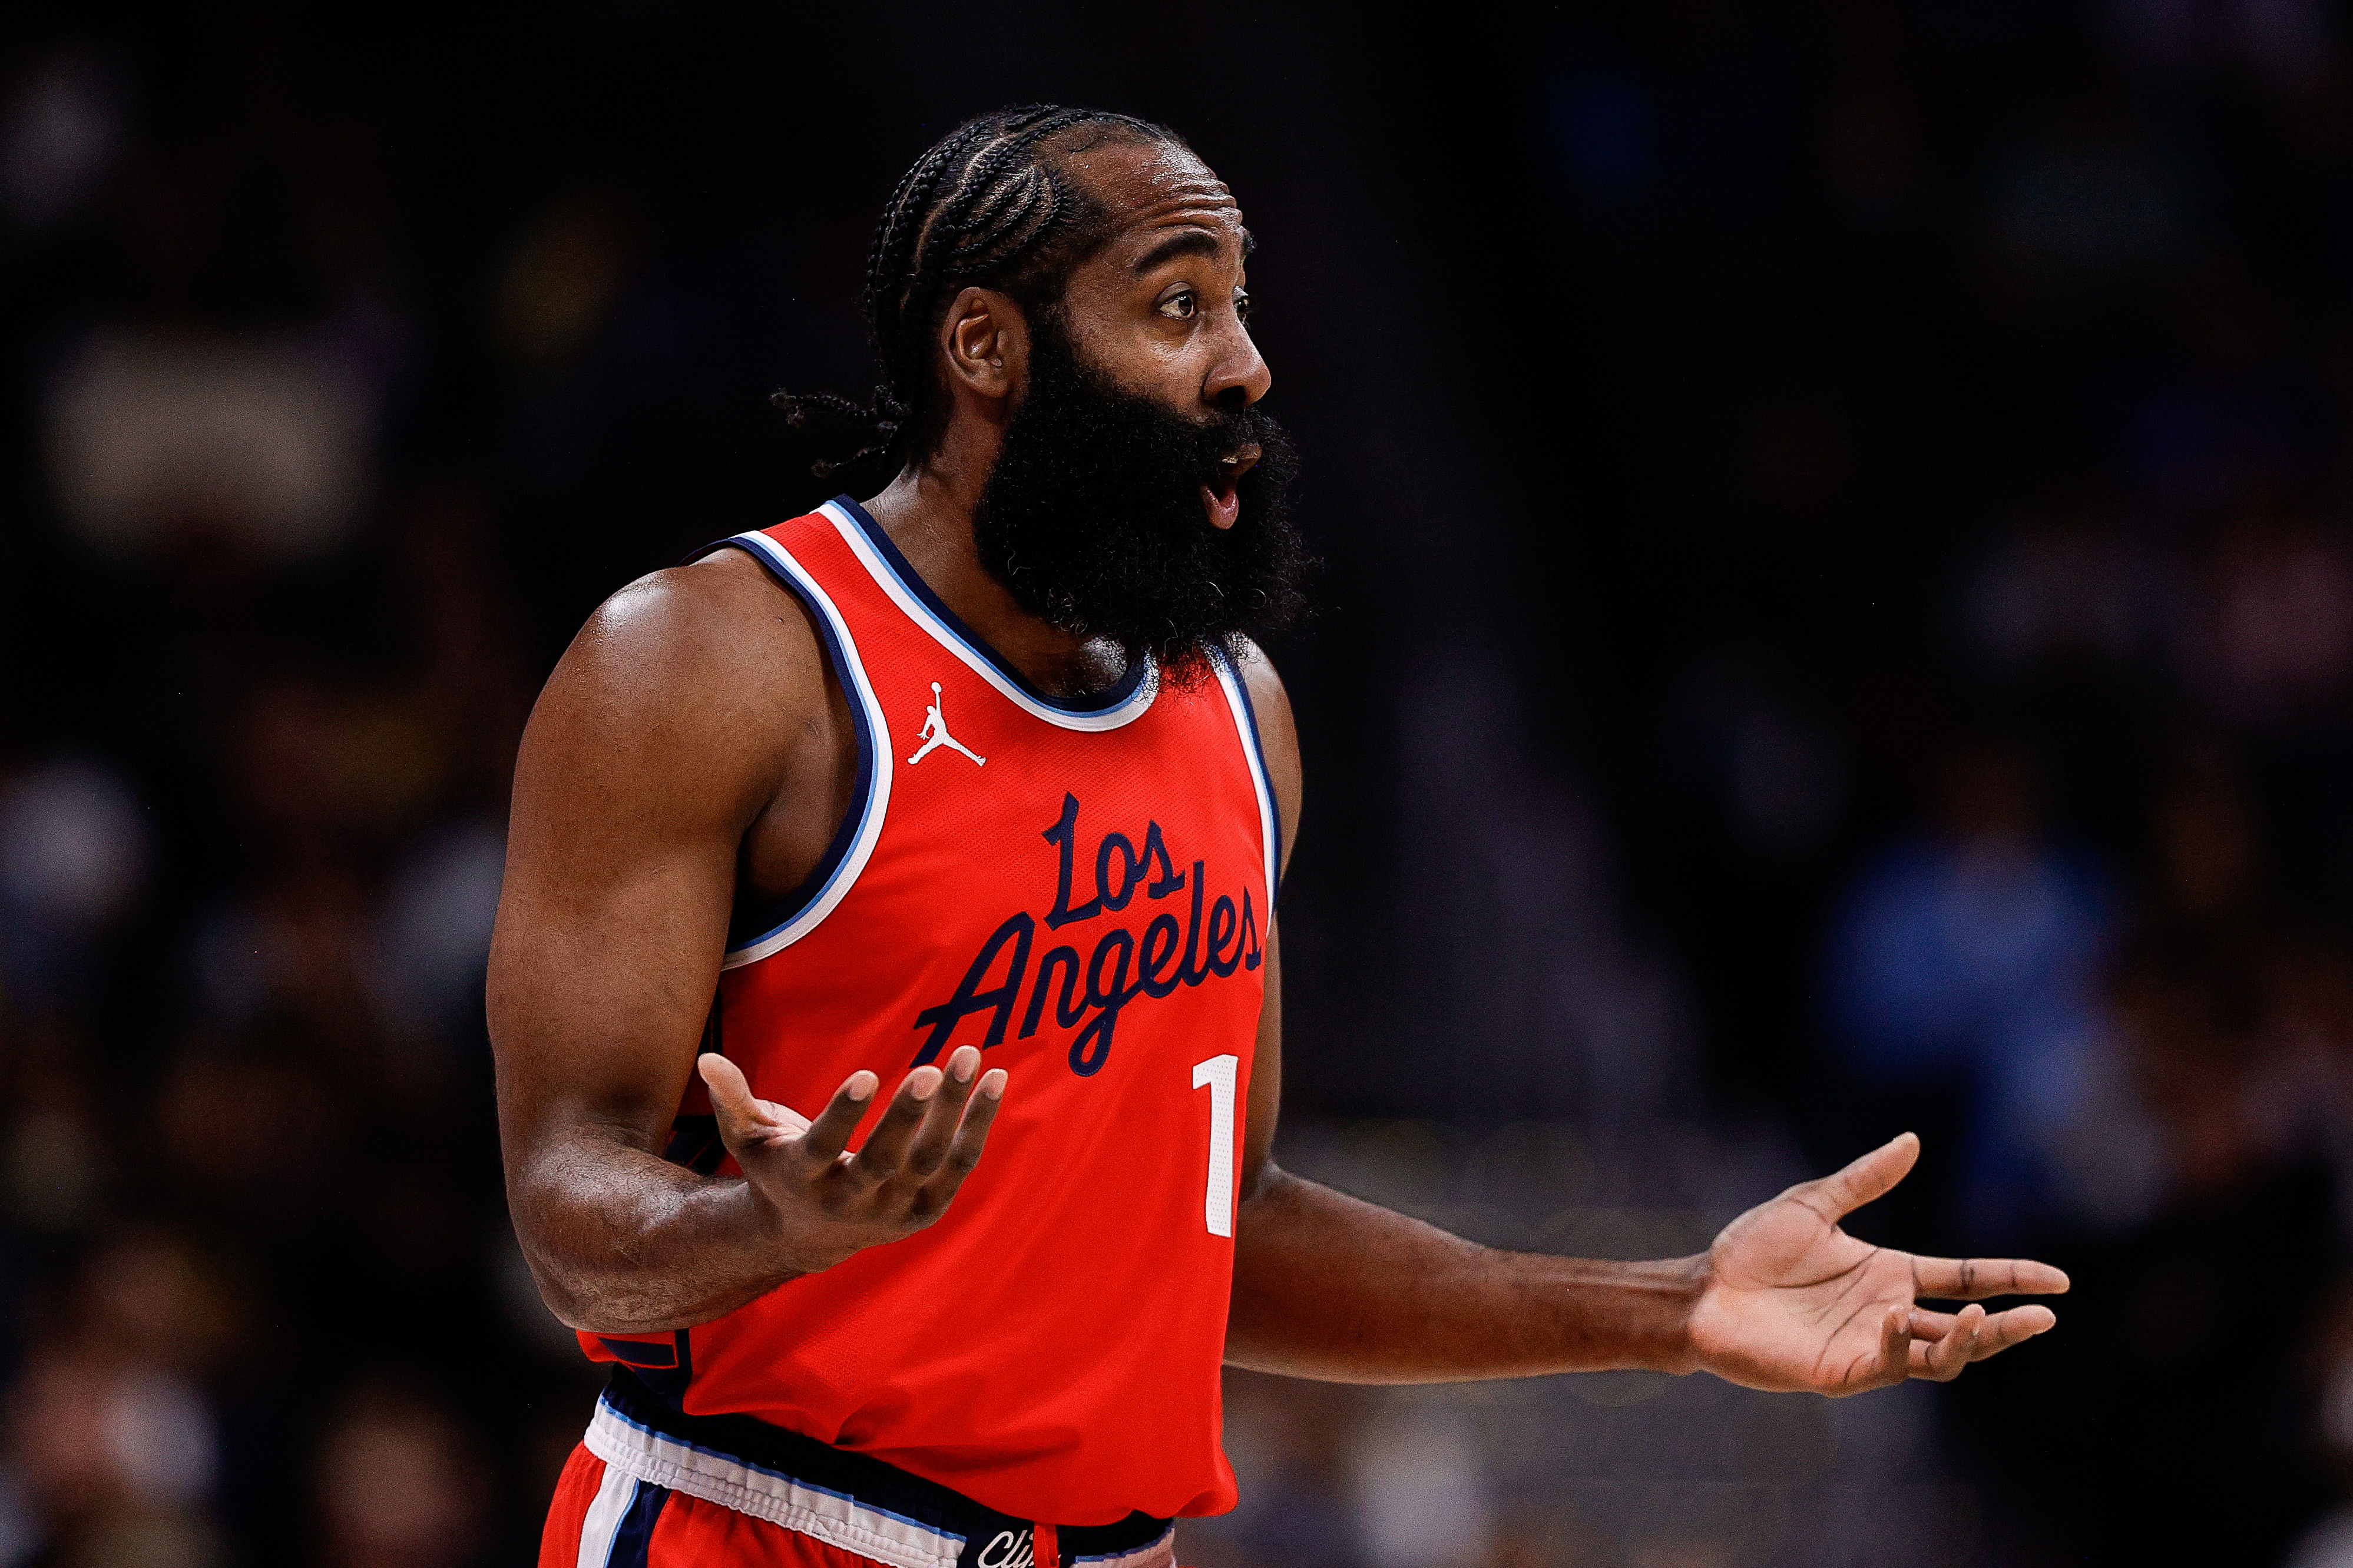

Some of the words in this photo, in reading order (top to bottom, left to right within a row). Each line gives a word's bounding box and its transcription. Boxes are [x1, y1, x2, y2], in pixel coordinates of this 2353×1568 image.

[1041, 791, 1185, 930] Los
[909, 860, 1261, 1076] Angeles
[1192, 1053, 1239, 1238] 1
